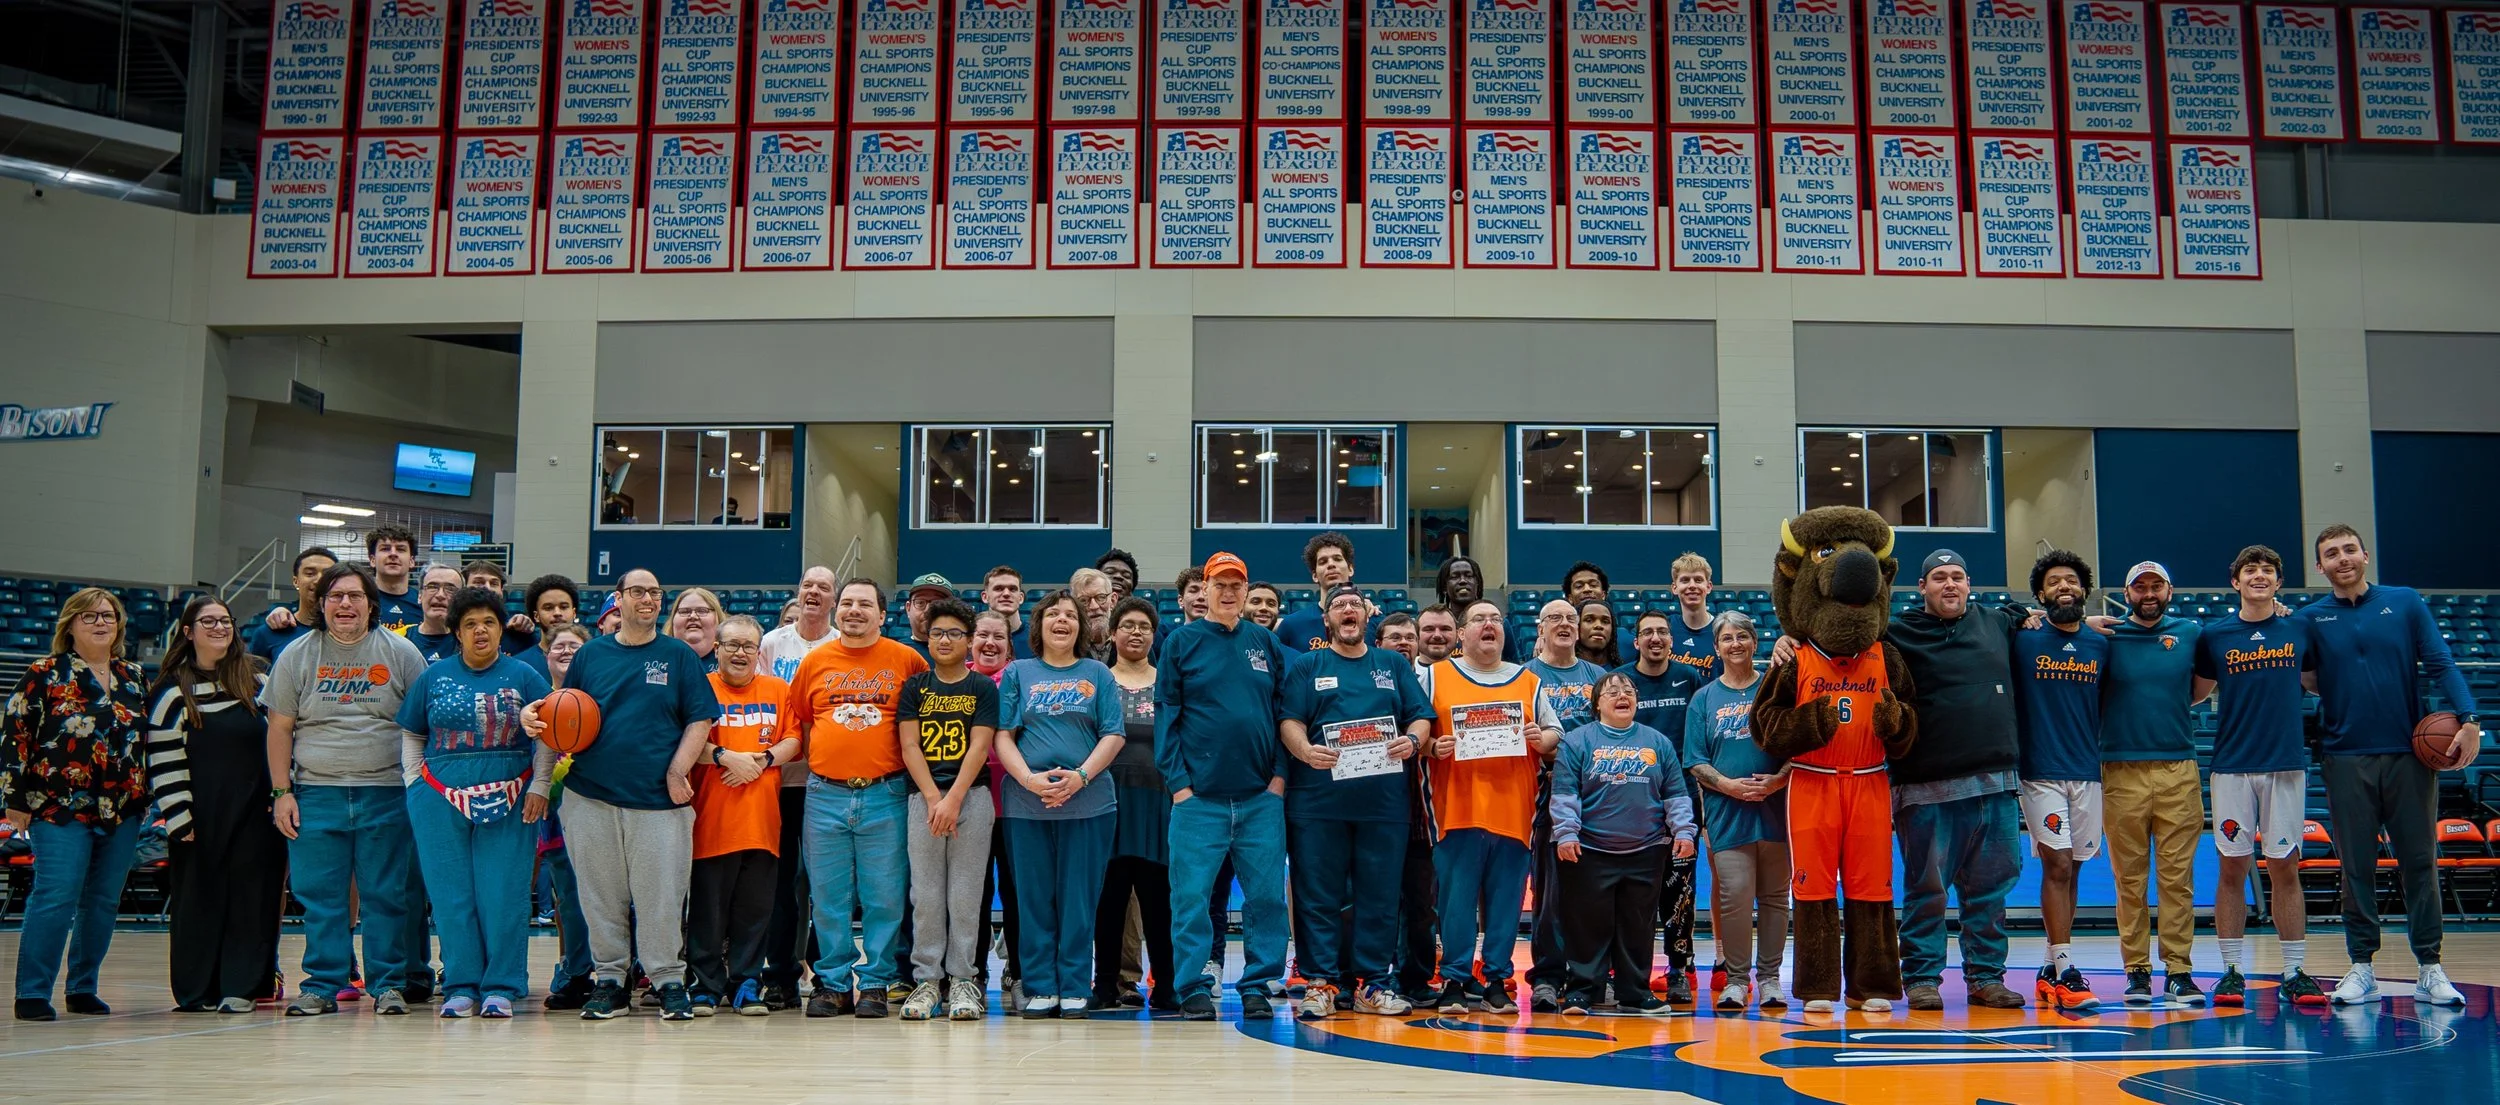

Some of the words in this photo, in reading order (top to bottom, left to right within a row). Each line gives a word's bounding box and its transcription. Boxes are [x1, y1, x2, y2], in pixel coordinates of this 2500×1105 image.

[1061, 10, 1135, 20] PATRIOT
[1266, 9, 1340, 18] PATRIOT
[1774, 14, 1845, 24] PATRIOT
[470, 17, 541, 28] PATRIOT
[568, 16, 640, 28] PATRIOT
[1061, 19, 1134, 28] LEAGUE
[1266, 18, 1340, 27] LEAGUE
[1774, 22, 1845, 33] LEAGUE
[2070, 22, 2141, 33] PATRIOT
[470, 27, 541, 38] LEAGUE
[568, 25, 639, 36] LEAGUE
[1068, 32, 1124, 42] WOMEN'S
[1283, 32, 1320, 42] MEN'S
[1793, 37, 1830, 47] MEN'S
[2070, 31, 2142, 42] LEAGUE
[464, 39, 542, 50] PRESIDENTS'
[574, 40, 630, 50] WOMEN'S
[2078, 44, 2133, 55] WOMEN'S
[1058, 47, 1081, 56] ALL
[1085, 46, 1133, 56] SPORTS
[1264, 46, 1287, 56] ALL
[1291, 46, 1339, 56] SPORTS
[1774, 51, 1796, 60] ALL
[1800, 51, 1847, 62] SPORTS
[490, 52, 516, 63] CUP
[564, 55, 587, 65] ALL
[590, 54, 637, 65] SPORTS
[1060, 61, 1131, 71] CHAMPIONS
[1262, 61, 1340, 70] CO-CHAMPIONS
[2071, 58, 2093, 68] ALL
[2096, 59, 2142, 70] SPORTS
[464, 66, 487, 76] ALL
[491, 64, 540, 75] SPORTS
[566, 68, 635, 80] CHAMPIONS
[1776, 65, 1846, 76] CHAMPIONS
[465, 77, 537, 88] CHAMPIONS
[1063, 76, 1127, 86] BUCKNELL
[1268, 74, 1333, 85] BUCKNELL
[2073, 72, 2141, 84] CHAMPIONS
[568, 83, 630, 94] BUCKNELL
[1780, 80, 1843, 91] BUCKNELL
[468, 90, 532, 101] BUCKNELL
[1060, 90, 1130, 100] UNIVERSITY
[1266, 89, 1335, 100] UNIVERSITY
[2077, 86, 2139, 98] BUCKNELL
[564, 98, 632, 108] UNIVERSITY
[1778, 94, 1845, 106] UNIVERSITY
[464, 102, 536, 113] UNIVERSITY
[1072, 105, 1116, 114] 1997-98
[1276, 105, 1322, 115] 1998-99
[2076, 101, 2141, 112] UNIVERSITY
[577, 113, 618, 123] 1992-93
[774, 107, 816, 118] 1994-95
[1790, 110, 1835, 120] 2000-01
[2086, 118, 2132, 128] 2001-02
[2280, 122, 2326, 134] 2002-03
[657, 156, 730, 167] PATRIOT
[1058, 152, 1133, 162] PATRIOT
[1472, 153, 1547, 163] PATRIOT
[266, 161, 337, 172] PATRIOT
[1058, 161, 1133, 172] LEAGUE
[1472, 162, 1547, 171] LEAGUE
[1880, 158, 1952, 169] PATRIOT
[266, 170, 337, 180] LEAGUE
[657, 166, 730, 176] LEAGUE
[1880, 166, 1952, 178] LEAGUE
[2178, 167, 2248, 178] PATRIOT
[654, 178, 728, 189] PRESIDENTS'
[1066, 175, 1122, 184] WOMEN'S
[1491, 176, 1527, 186] MEN'S
[2179, 176, 2248, 186] LEAGUE
[272, 184, 326, 194] WOMEN'S
[1888, 181, 1944, 192] WOMEN'S
[678, 191, 703, 202] CUP
[1056, 190, 1079, 200] ALL
[1083, 189, 1132, 200] SPORTS
[1472, 190, 1495, 199] ALL
[1498, 190, 1547, 200] SPORTS
[2187, 190, 2241, 200] WOMEN'S
[262, 199, 284, 209] ALL
[288, 198, 334, 209] SPORTS
[1881, 196, 1903, 205] ALL
[1907, 196, 1954, 206] SPORTS
[652, 204, 675, 214] ALL
[679, 202, 727, 214] SPORTS
[1058, 204, 1129, 215] CHAMPIONS
[1474, 204, 1545, 214] CHAMPIONS
[2179, 204, 2202, 214] ALL
[2204, 204, 2251, 215] SPORTS
[262, 212, 330, 224] CHAMPIONS
[654, 215, 724, 226] CHAMPIONS
[1882, 210, 1952, 221] CHAMPIONS
[1061, 219, 1126, 230] BUCKNELL
[1478, 219, 1542, 229] BUCKNELL
[2181, 218, 2250, 230] CHAMPIONS
[264, 228, 326, 238] BUCKNELL
[656, 228, 720, 239] BUCKNELL
[1887, 225, 1950, 236] BUCKNELL
[1058, 234, 1127, 244] UNIVERSITY
[1476, 234, 1544, 244] UNIVERSITY
[2186, 233, 2248, 244] BUCKNELL
[261, 242, 327, 254] UNIVERSITY
[654, 241, 722, 252] UNIVERSITY
[1886, 240, 1952, 250] UNIVERSITY
[2184, 245, 2250, 256] UNIVERSITY
[664, 254, 712, 264] 2005-06
[763, 252, 811, 263] 2006-07
[1068, 251, 1117, 261] 2007-08
[1275, 250, 1324, 260] 2008-09
[1486, 250, 1534, 260] 2009-10
[270, 259, 316, 269] 2003-04
[1898, 256, 1942, 267] 2010-11
[2096, 260, 2142, 270] 2012-13
[2196, 261, 2241, 272] 2015-16
[2225, 643, 2295, 665] Bucknell
[2036, 655, 2098, 675] Bucknell
[2228, 660, 2295, 674] BASKETBALL
[317, 666, 366, 679] SLAM
[2036, 672, 2097, 684] BASKETBALL
[316, 680, 375, 694] DUNK
[825, 667, 896, 699] Christy's
[1811, 676, 1877, 694] Bucknell
[828, 693, 891, 705] CREW
[918, 692, 977, 717] LAKERS
[1636, 700, 1657, 709] ENN
[1658, 698, 1687, 707] STATE
[712, 703, 777, 727] ISON
[1838, 696, 1852, 724] 6
[921, 719, 967, 761] 23
[1593, 749, 1639, 760] SLAM
[1594, 759, 1647, 774] DUNK
[2446, 825, 2469, 833] BISON
